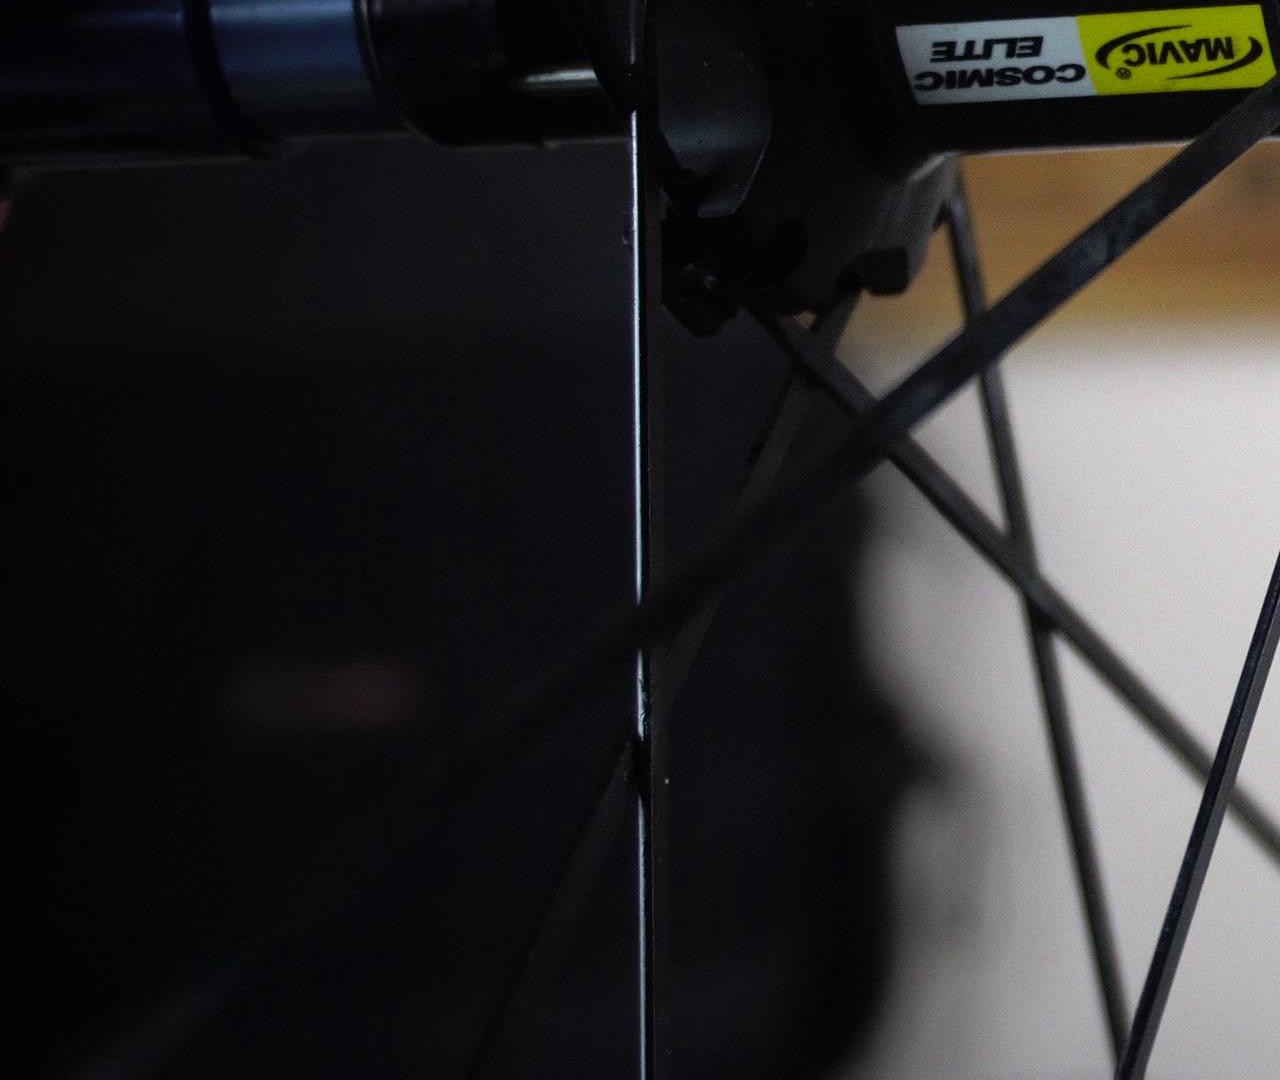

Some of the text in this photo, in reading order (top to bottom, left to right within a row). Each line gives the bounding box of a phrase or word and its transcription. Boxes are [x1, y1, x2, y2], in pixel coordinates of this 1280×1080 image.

[931, 35, 1043, 62] ELITE
[1123, 36, 1235, 66] MAVIC
[915, 64, 1086, 91] COSMIC
